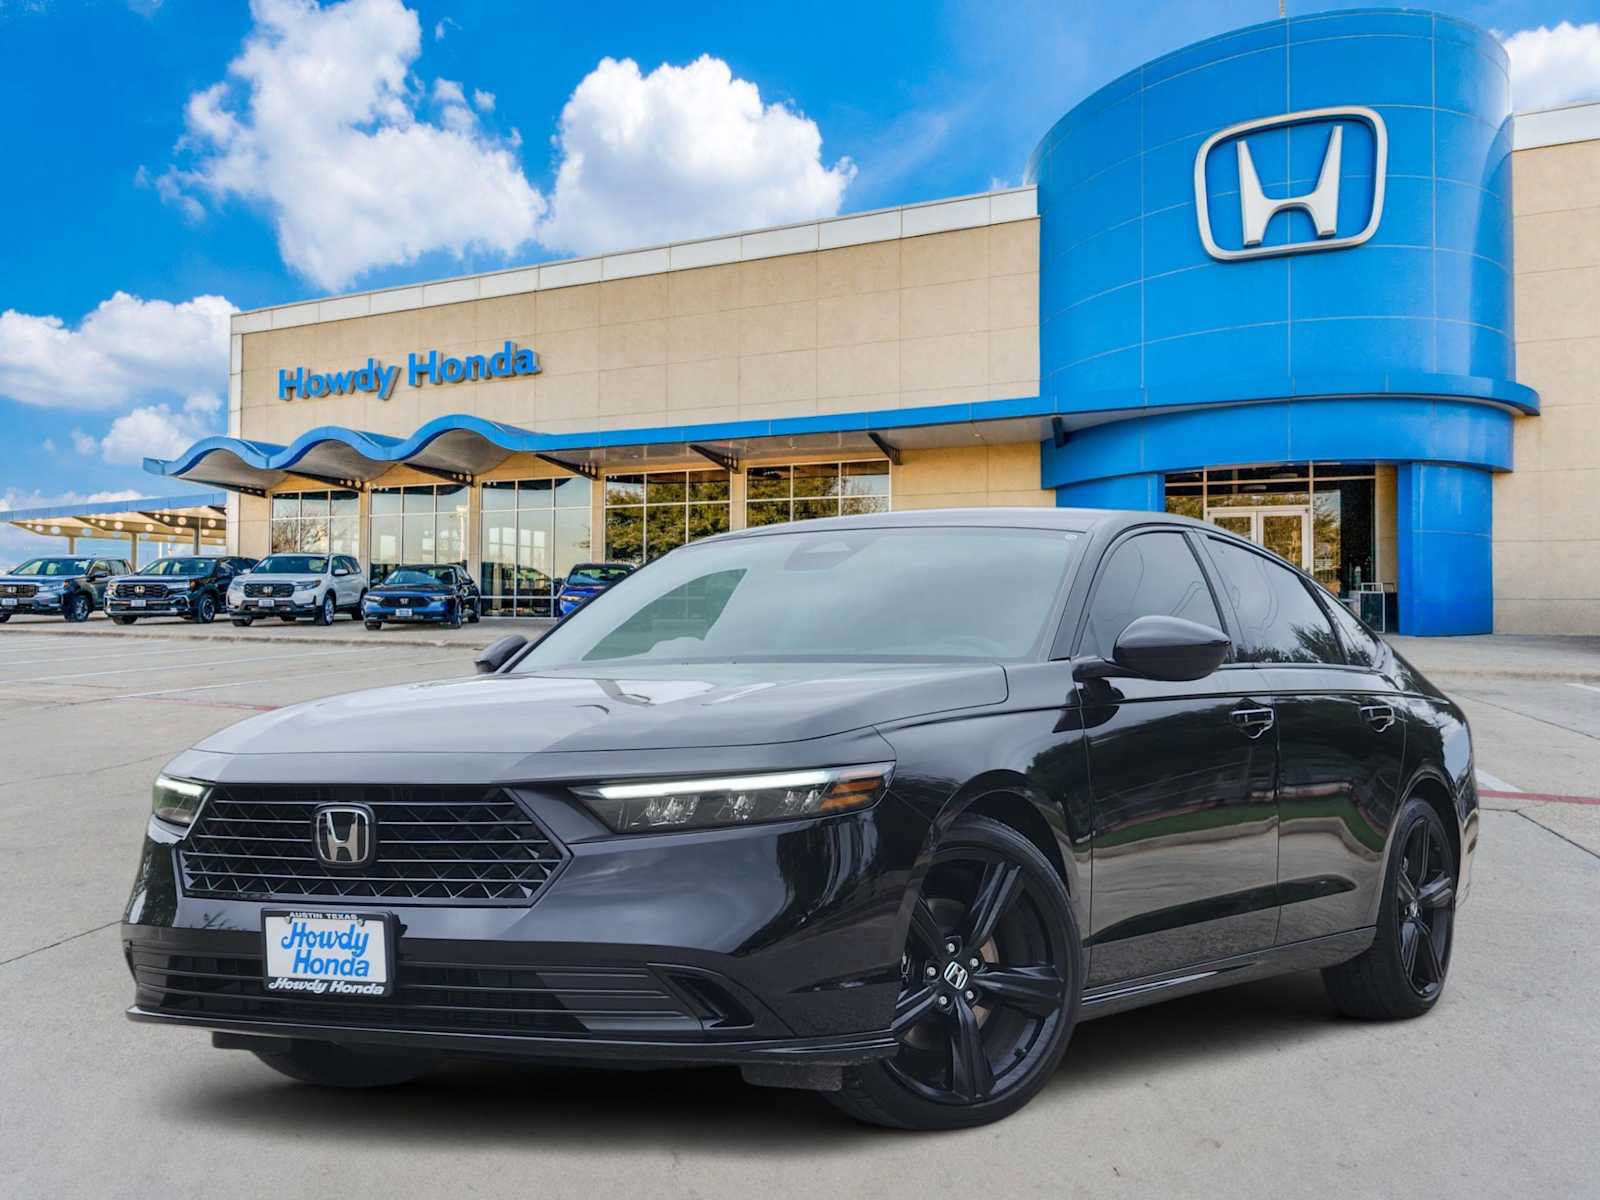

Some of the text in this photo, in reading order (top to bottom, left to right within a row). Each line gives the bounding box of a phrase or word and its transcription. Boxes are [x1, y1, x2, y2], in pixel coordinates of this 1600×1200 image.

[278, 340, 542, 401] Howdy Honda
[289, 911, 323, 919] AUSTIN
[281, 922, 369, 957] Howdy
[292, 949, 369, 977] Honda
[268, 977, 385, 995] Howdy Honda
